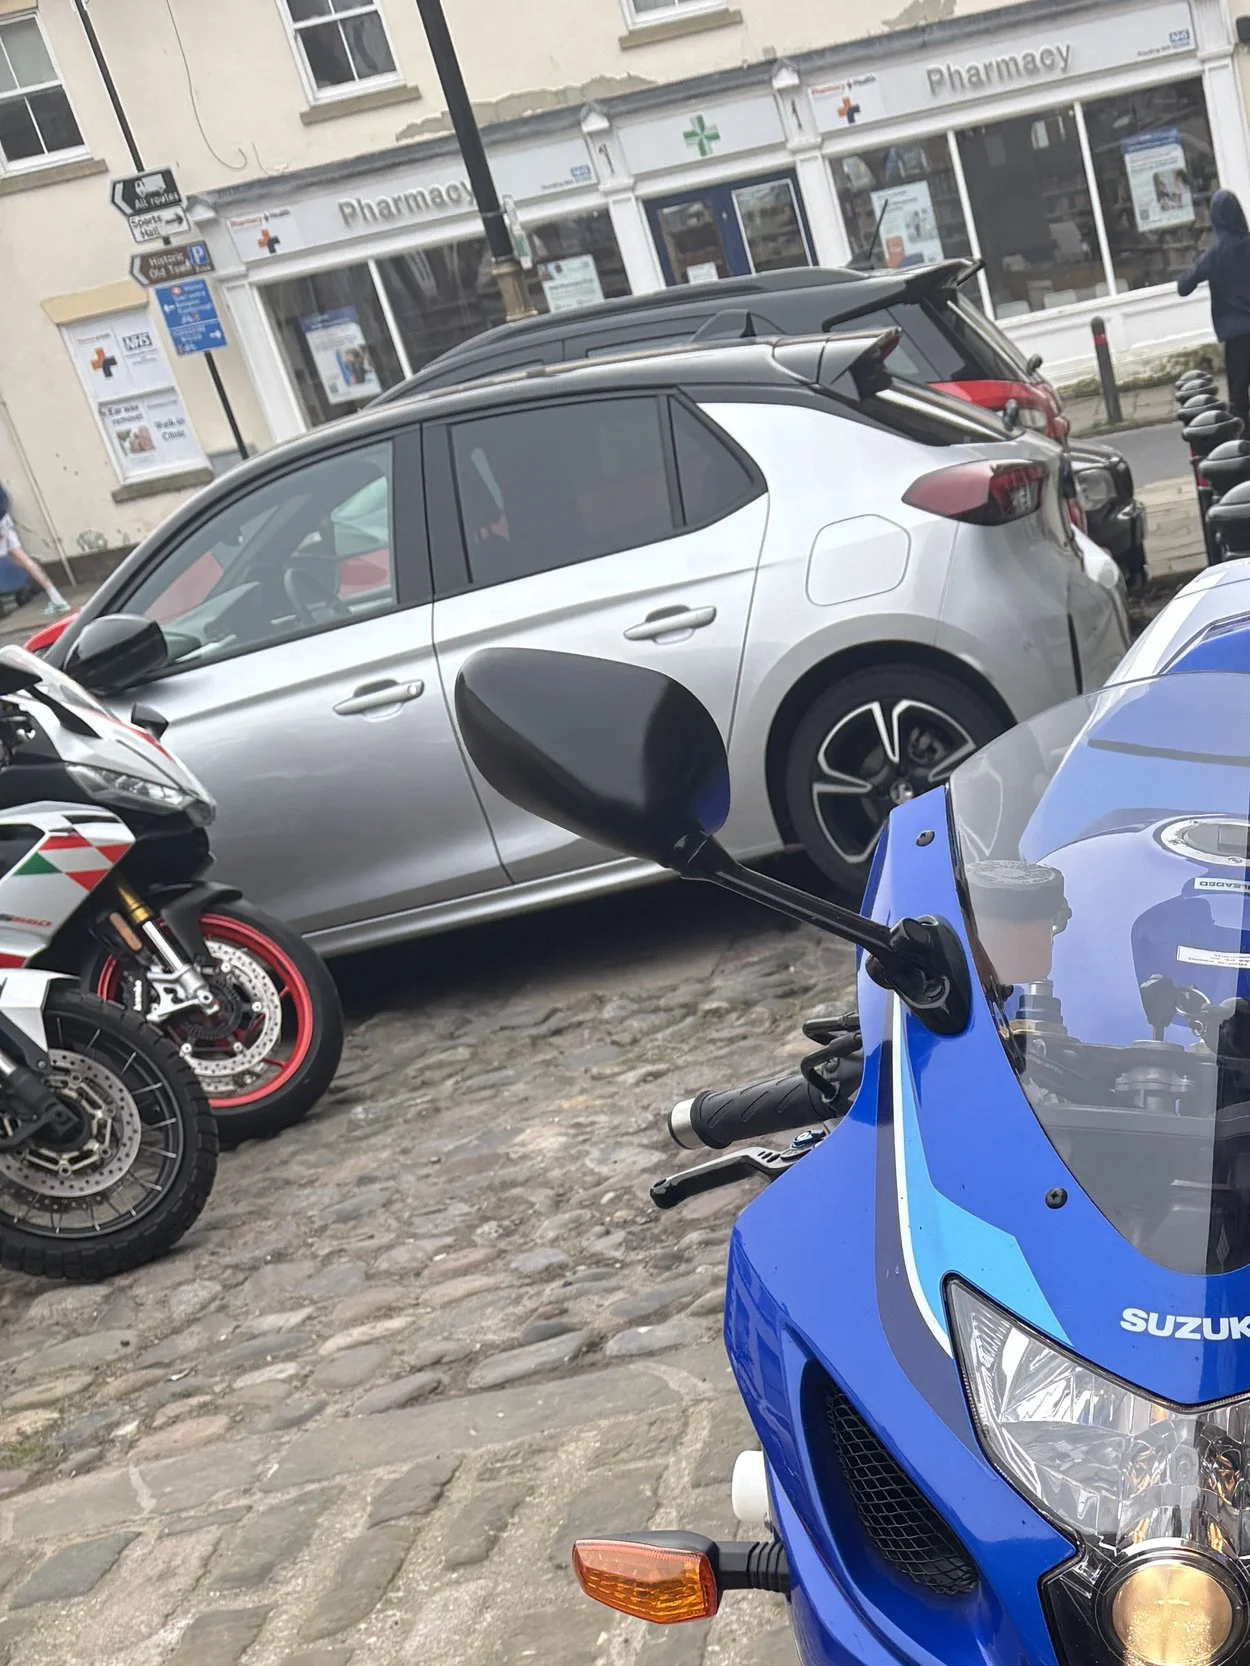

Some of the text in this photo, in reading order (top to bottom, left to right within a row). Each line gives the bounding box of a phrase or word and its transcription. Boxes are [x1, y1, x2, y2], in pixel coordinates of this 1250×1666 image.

[926, 44, 1071, 96] Pharmacy
[134, 191, 179, 210] All routes
[130, 215, 163, 228] Sports
[141, 227, 160, 239] Hall
[148, 251, 184, 267] Historic
[123, 332, 152, 350] NHS
